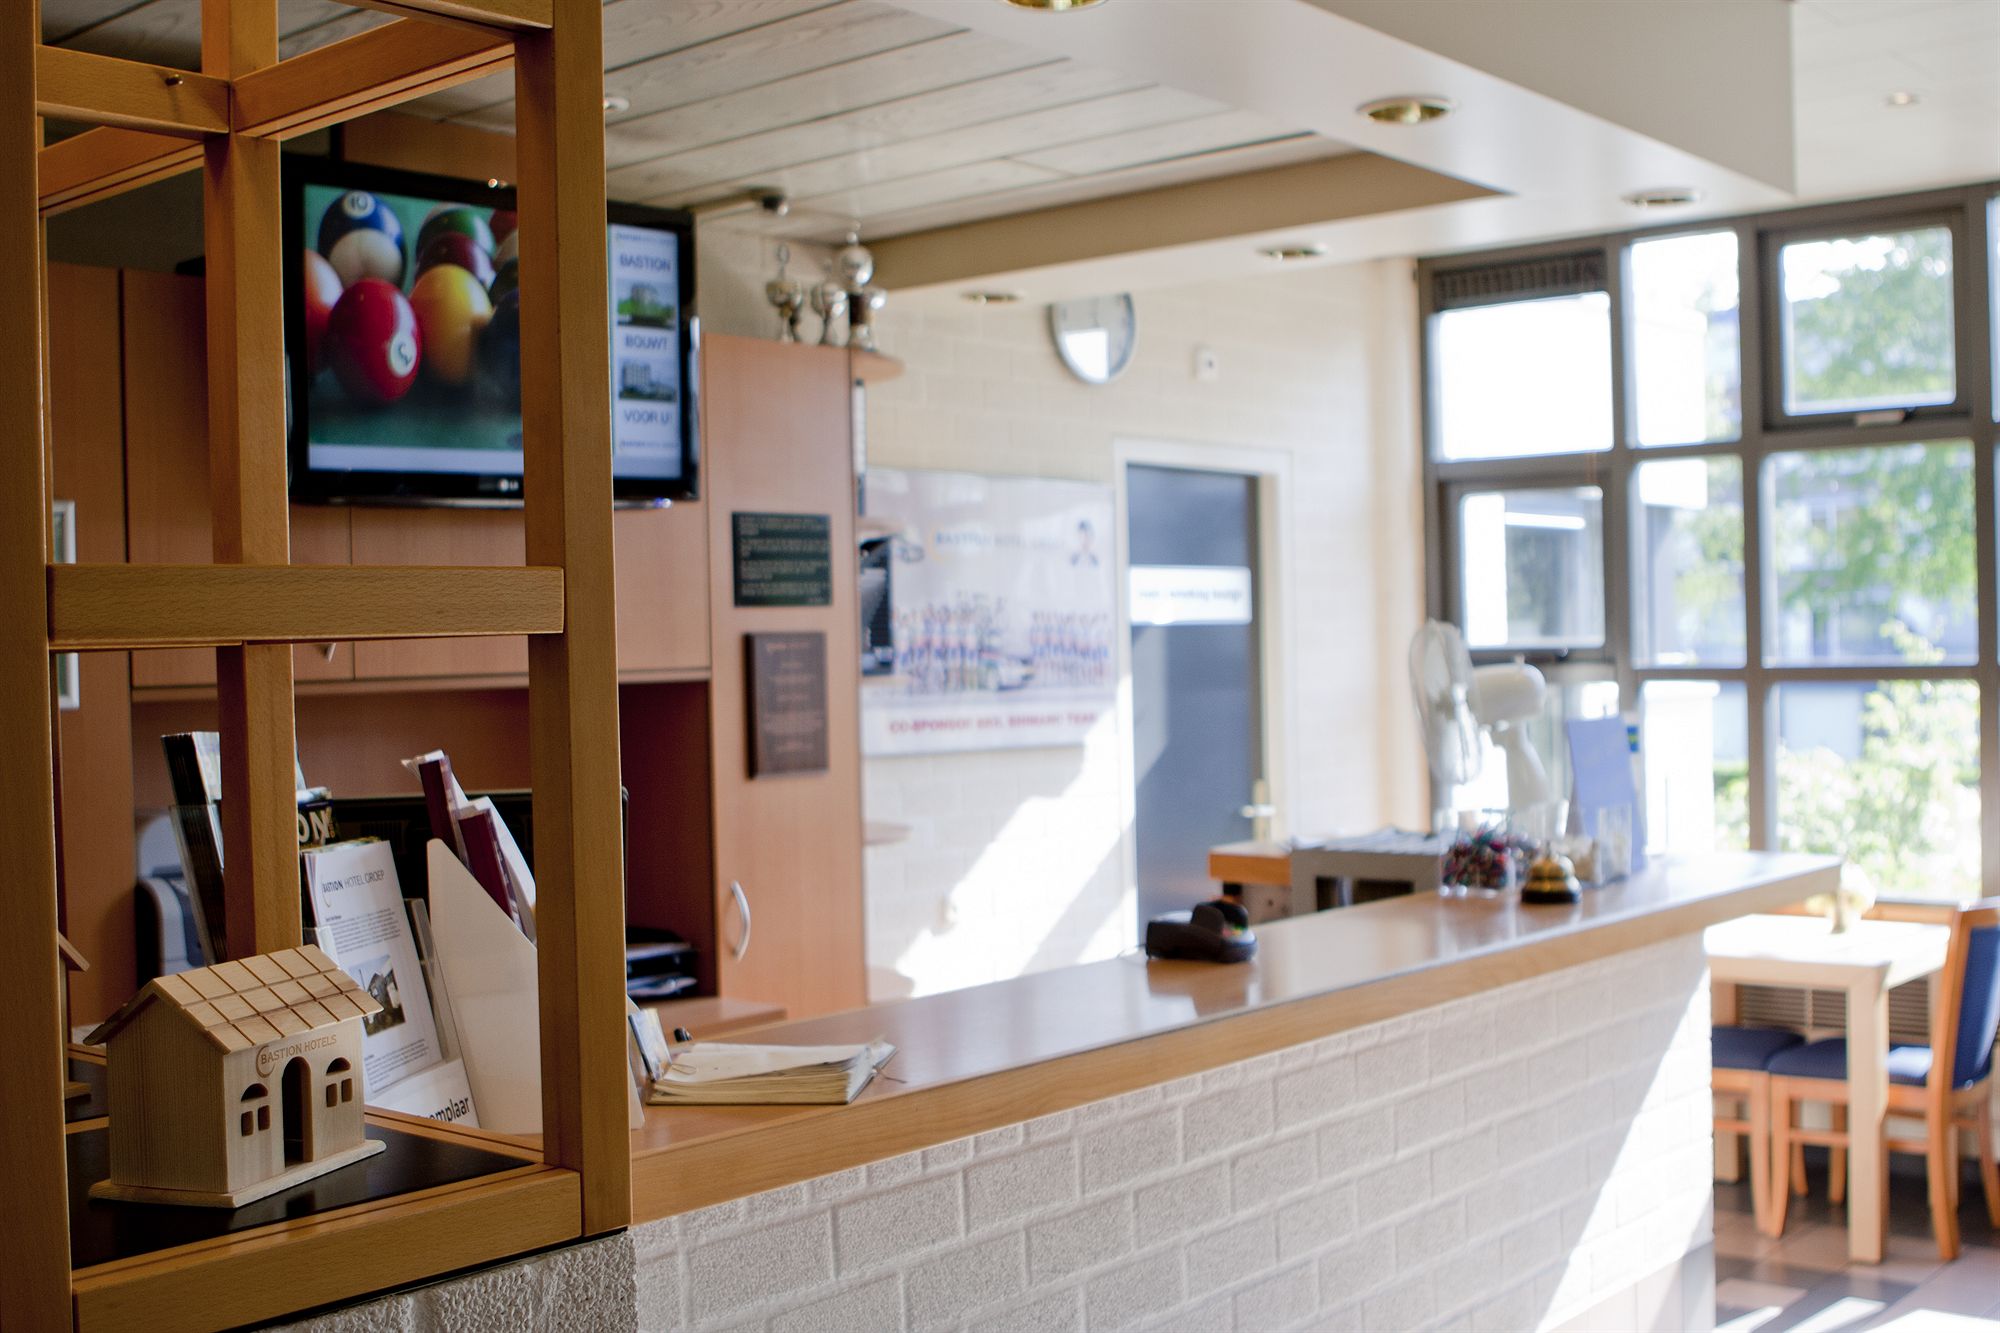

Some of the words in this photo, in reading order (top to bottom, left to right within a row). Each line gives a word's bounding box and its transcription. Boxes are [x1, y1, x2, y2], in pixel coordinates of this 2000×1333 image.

[620, 253, 672, 272] BASTION
[623, 408, 658, 424] VOOR
[344, 874, 365, 889] HOTEL
[260, 1043, 302, 1065] BASTION
[304, 1034, 337, 1052] HOTELS
